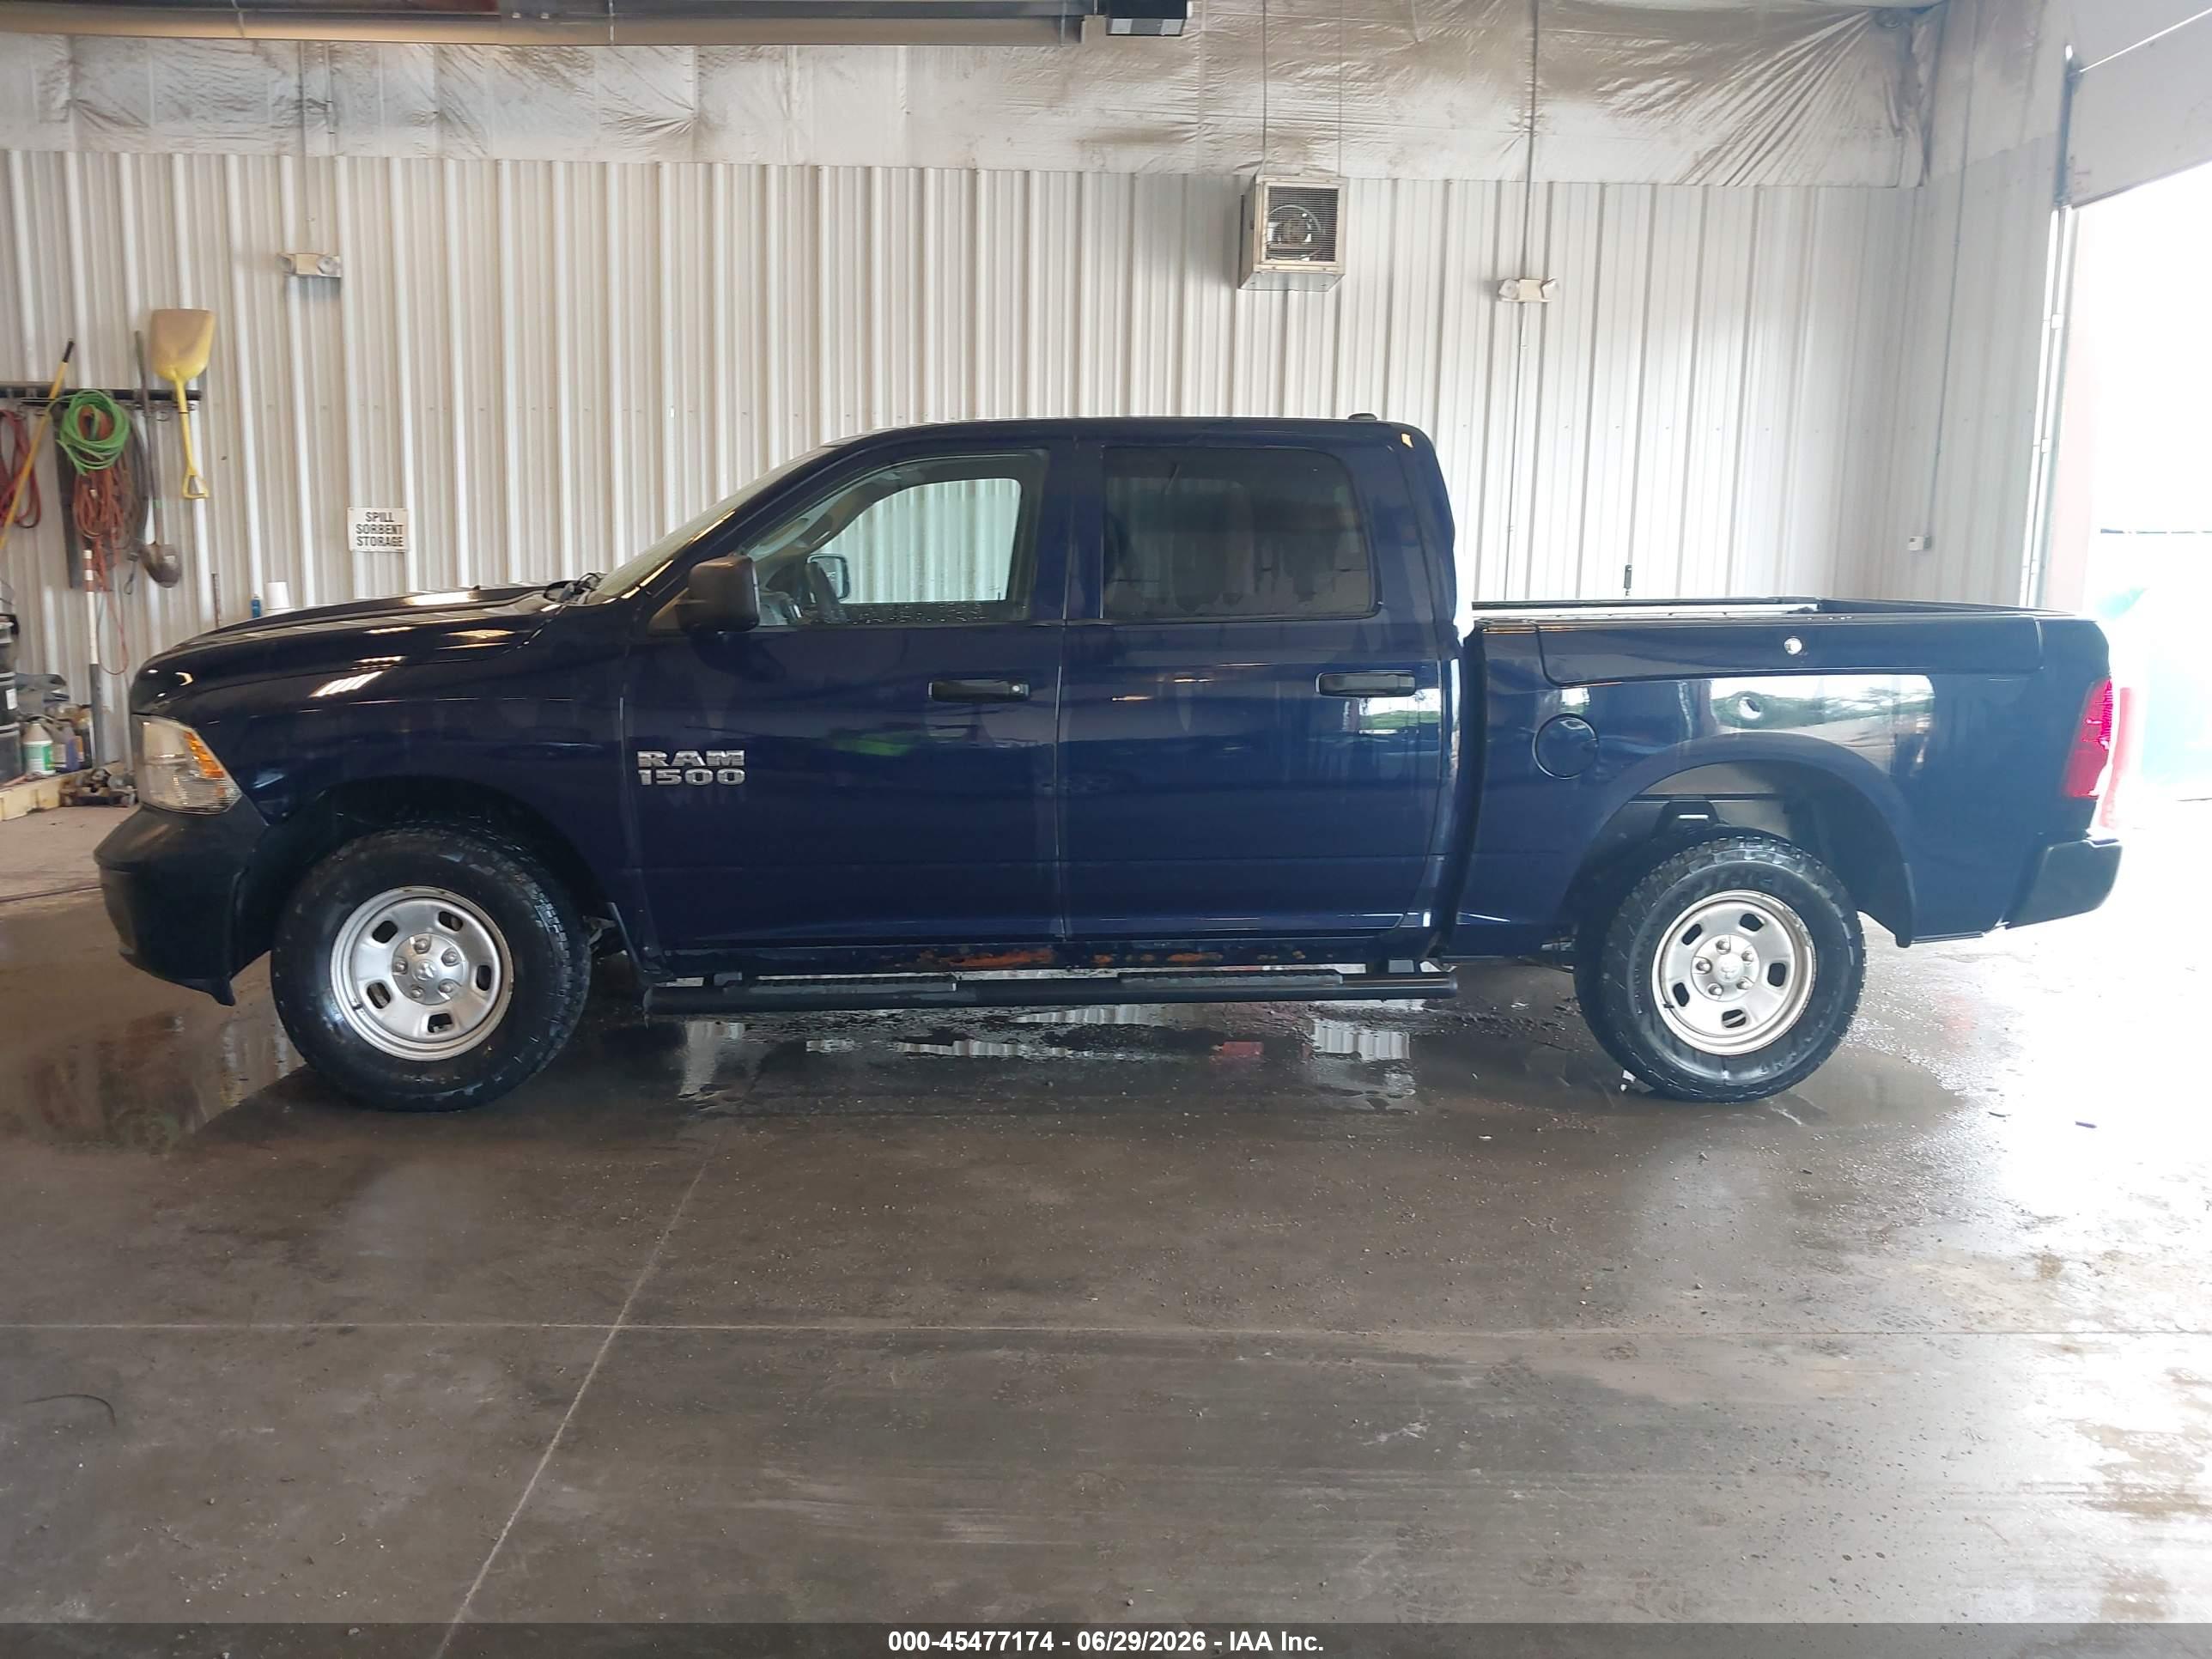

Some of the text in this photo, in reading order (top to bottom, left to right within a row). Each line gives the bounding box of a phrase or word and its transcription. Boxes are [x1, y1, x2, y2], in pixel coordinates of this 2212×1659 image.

[365, 511, 395, 522] SPILL
[637, 750, 745, 767] RAM
[637, 768, 745, 786] 1500
